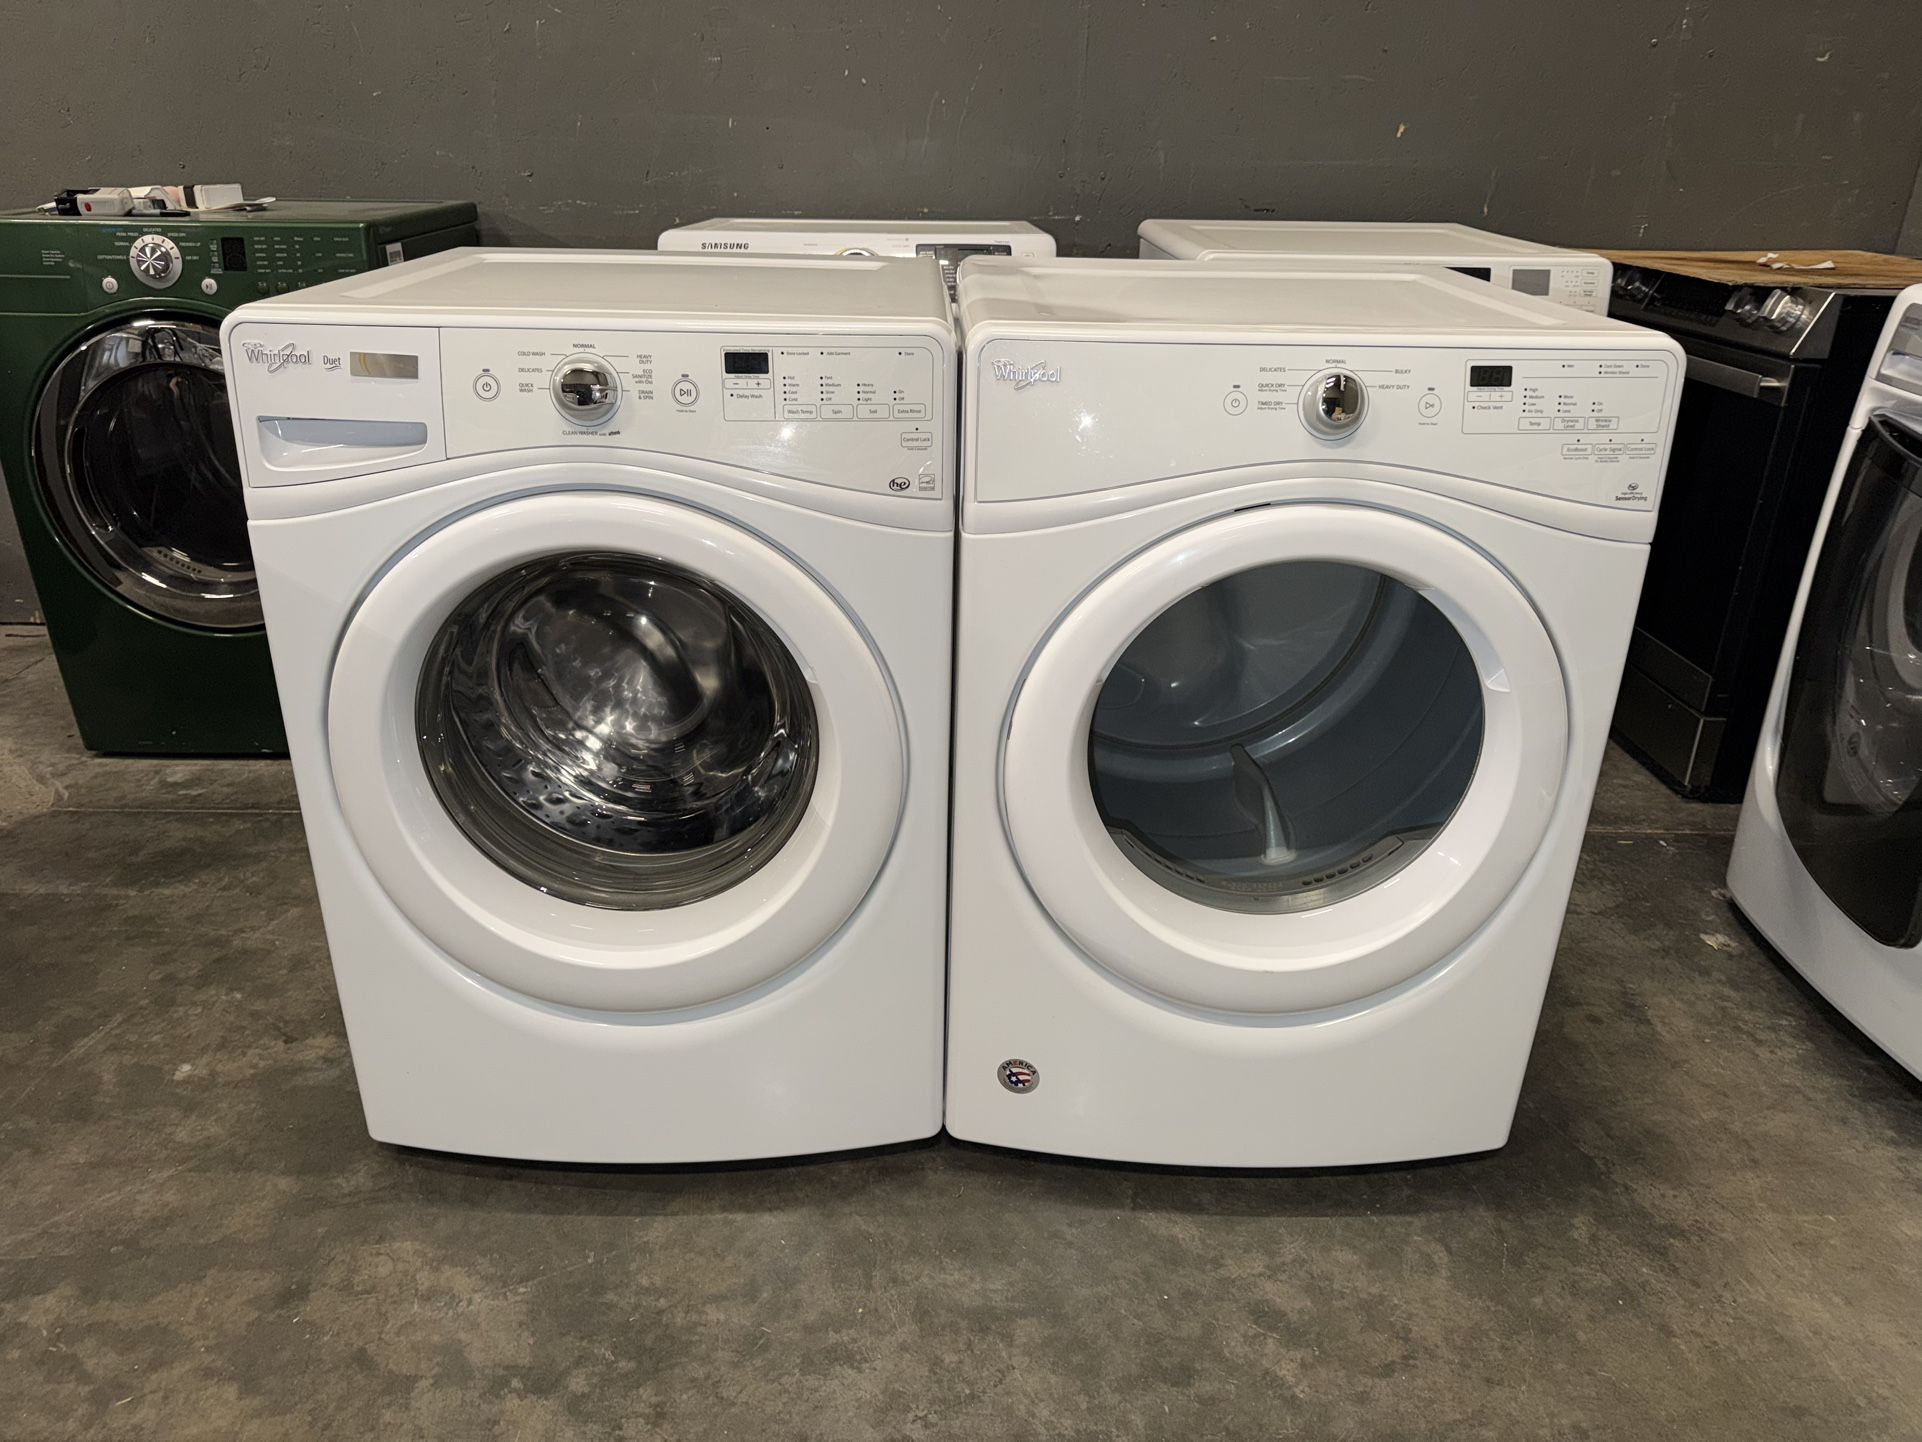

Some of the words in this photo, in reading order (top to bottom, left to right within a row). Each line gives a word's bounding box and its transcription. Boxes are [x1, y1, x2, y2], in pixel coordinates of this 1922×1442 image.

[243, 346, 312, 371] Whirlpool
[323, 355, 341, 366] Duet
[992, 362, 1061, 385] Whirlpool
[1002, 1060, 1037, 1076] AMERICA
